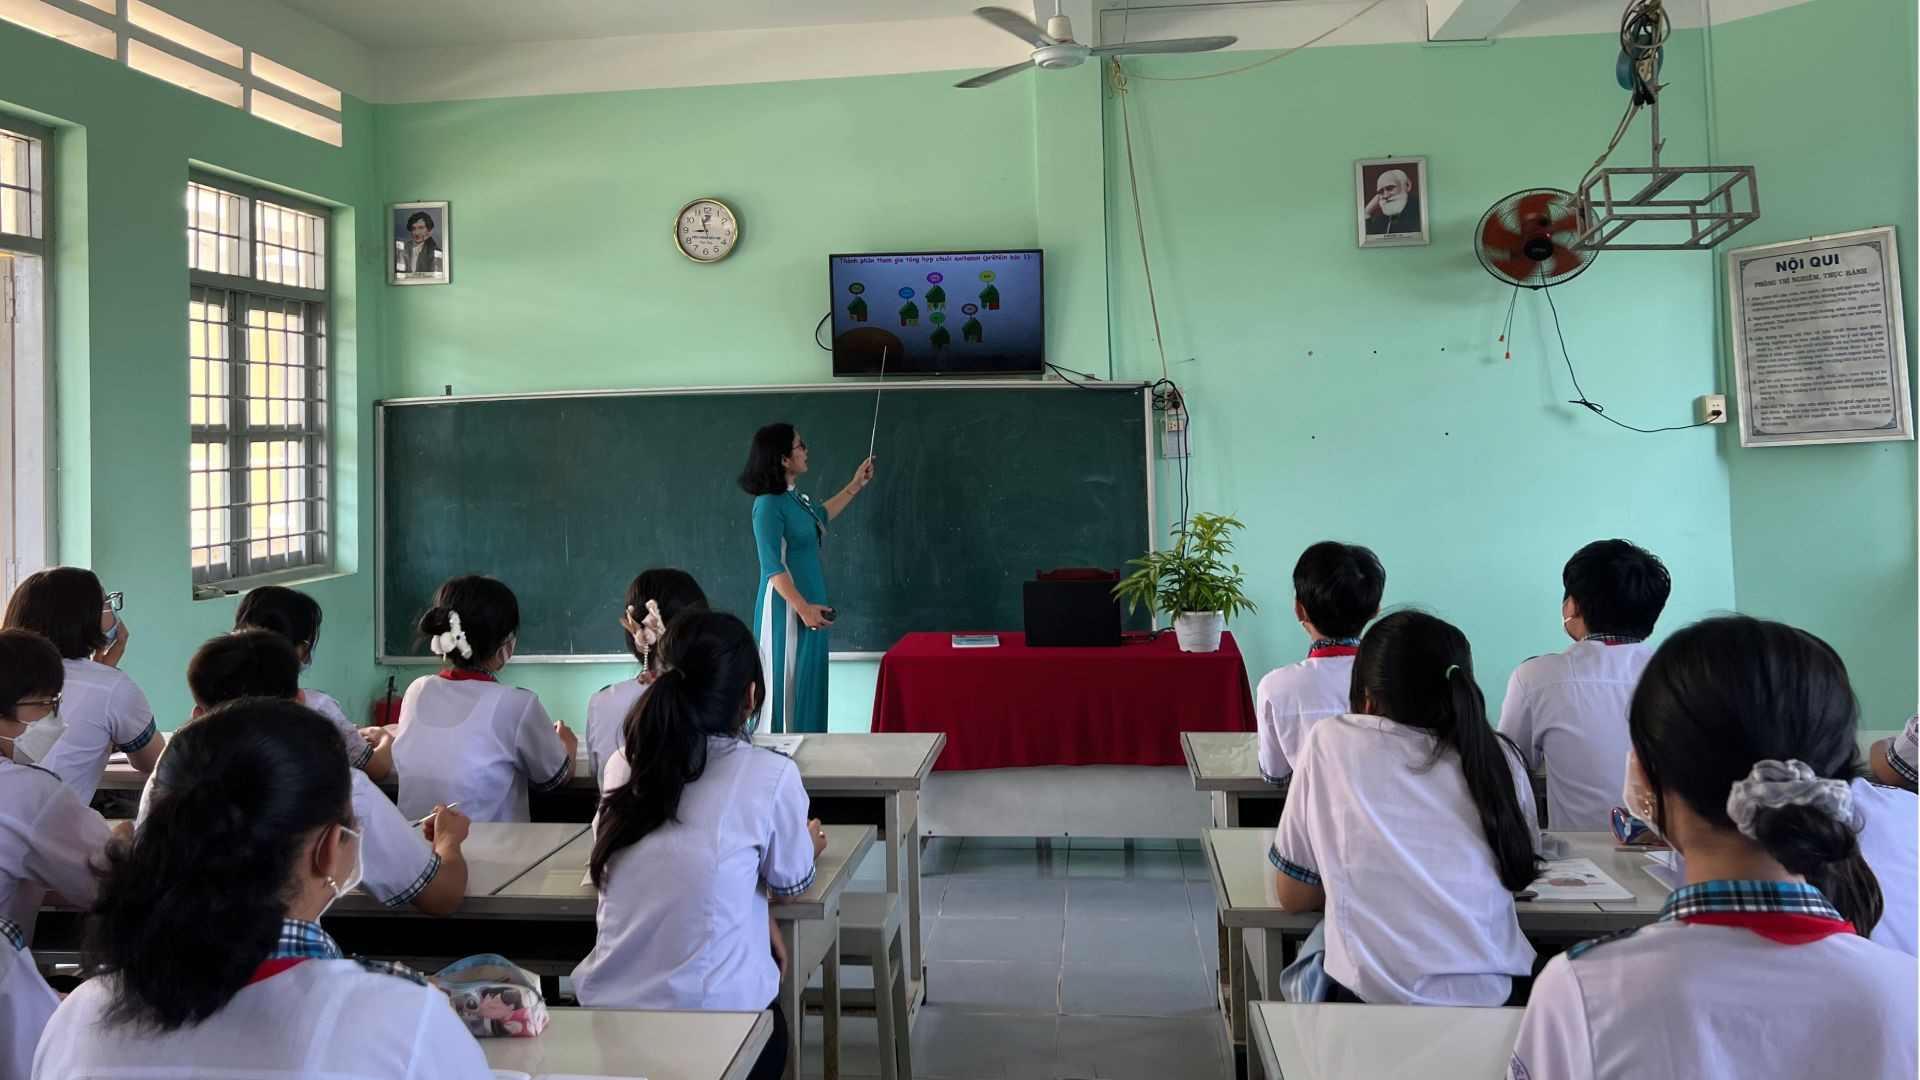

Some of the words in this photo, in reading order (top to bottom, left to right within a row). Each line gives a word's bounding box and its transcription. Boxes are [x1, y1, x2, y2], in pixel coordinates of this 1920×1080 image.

[1776, 257, 1804, 273] NỘI
[1810, 253, 1839, 268] QUI
[1754, 278, 1777, 288] PHÒNG
[1846, 267, 1868, 276] HÀNH
